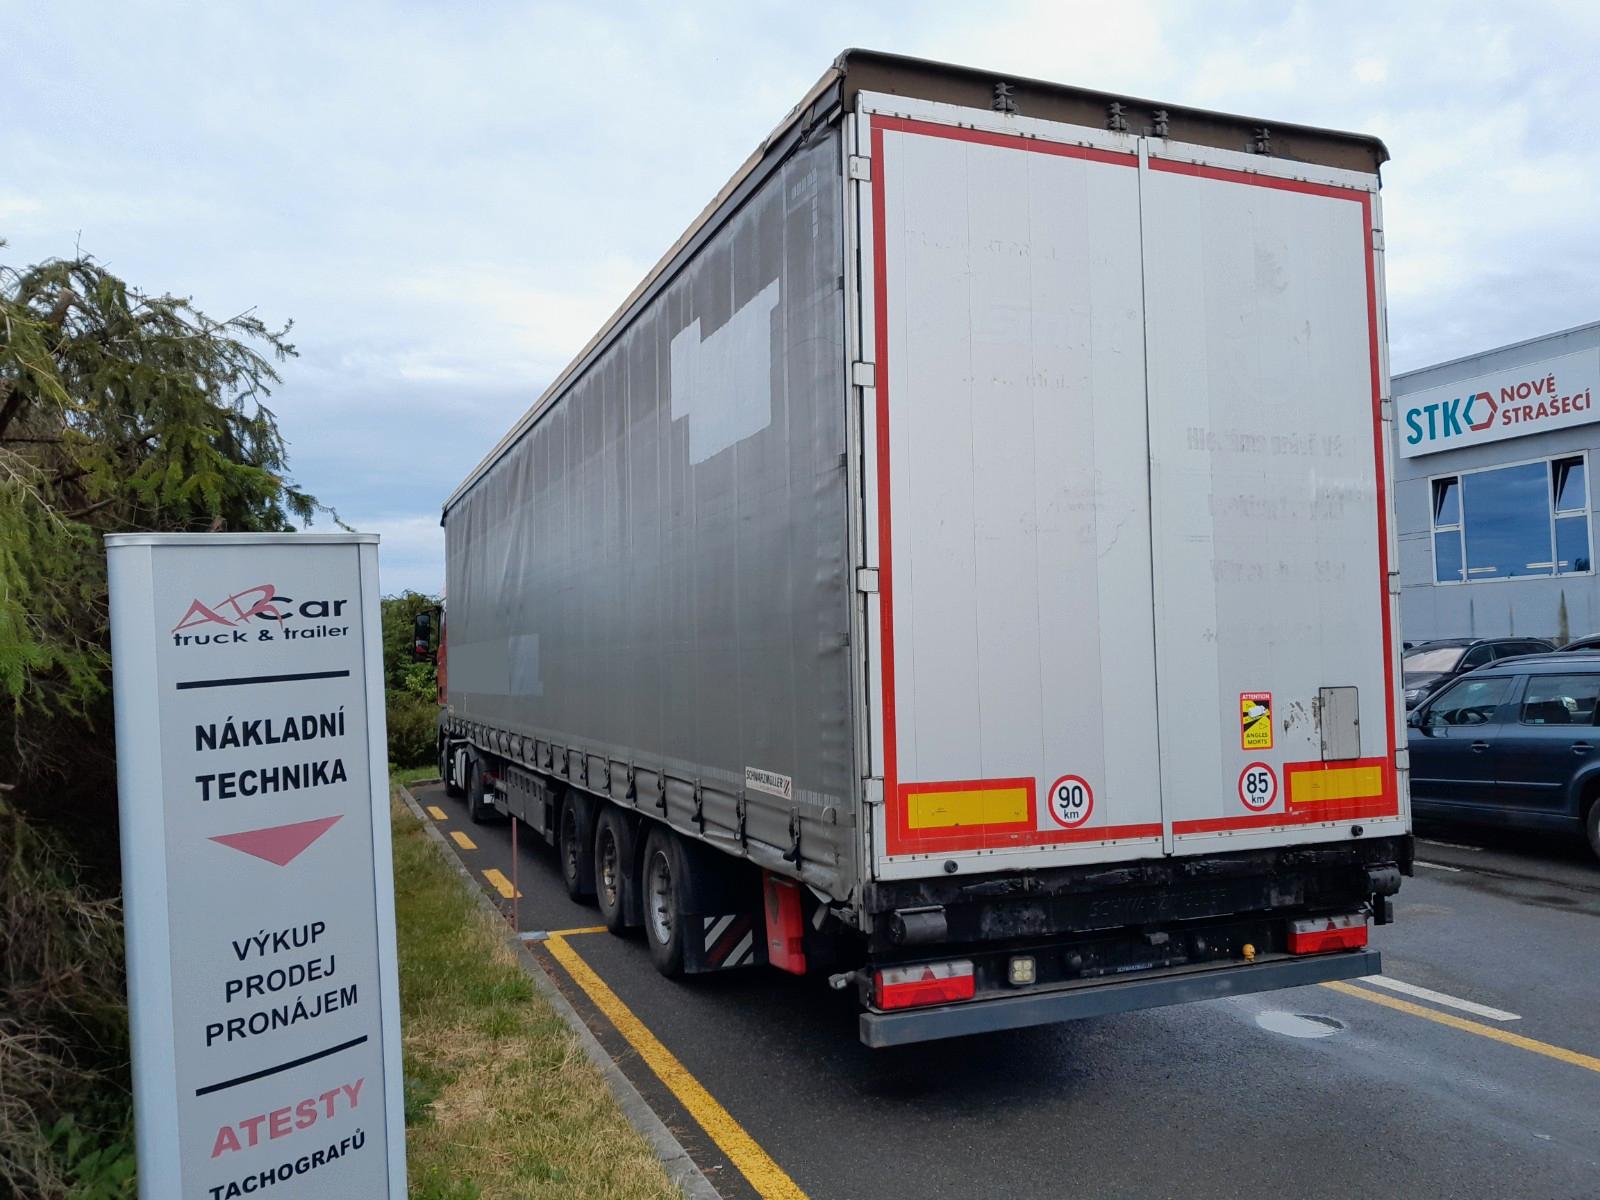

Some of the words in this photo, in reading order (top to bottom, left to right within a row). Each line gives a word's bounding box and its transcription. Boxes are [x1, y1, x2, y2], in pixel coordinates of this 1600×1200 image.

[1501, 373, 1556, 403] NOVÉ
[1502, 388, 1591, 426] STRAŠECÍ
[173, 630, 248, 647] truck
[258, 629, 274, 641] &
[283, 624, 349, 640] trailer
[195, 706, 345, 751] NÁKLADNÍ
[195, 758, 347, 801] TECHNIKA
[1058, 785, 1083, 808] 90
[1246, 772, 1269, 794] 85
[1064, 809, 1079, 819] km
[1252, 795, 1265, 804] km
[232, 921, 326, 961] VÝKUP
[225, 955, 335, 1003] PRODEJ
[206, 984, 358, 1047] PRONÁJEM
[211, 1078, 365, 1158] ATESTY
[208, 1128, 366, 1200] TACHOGRAFŮ
